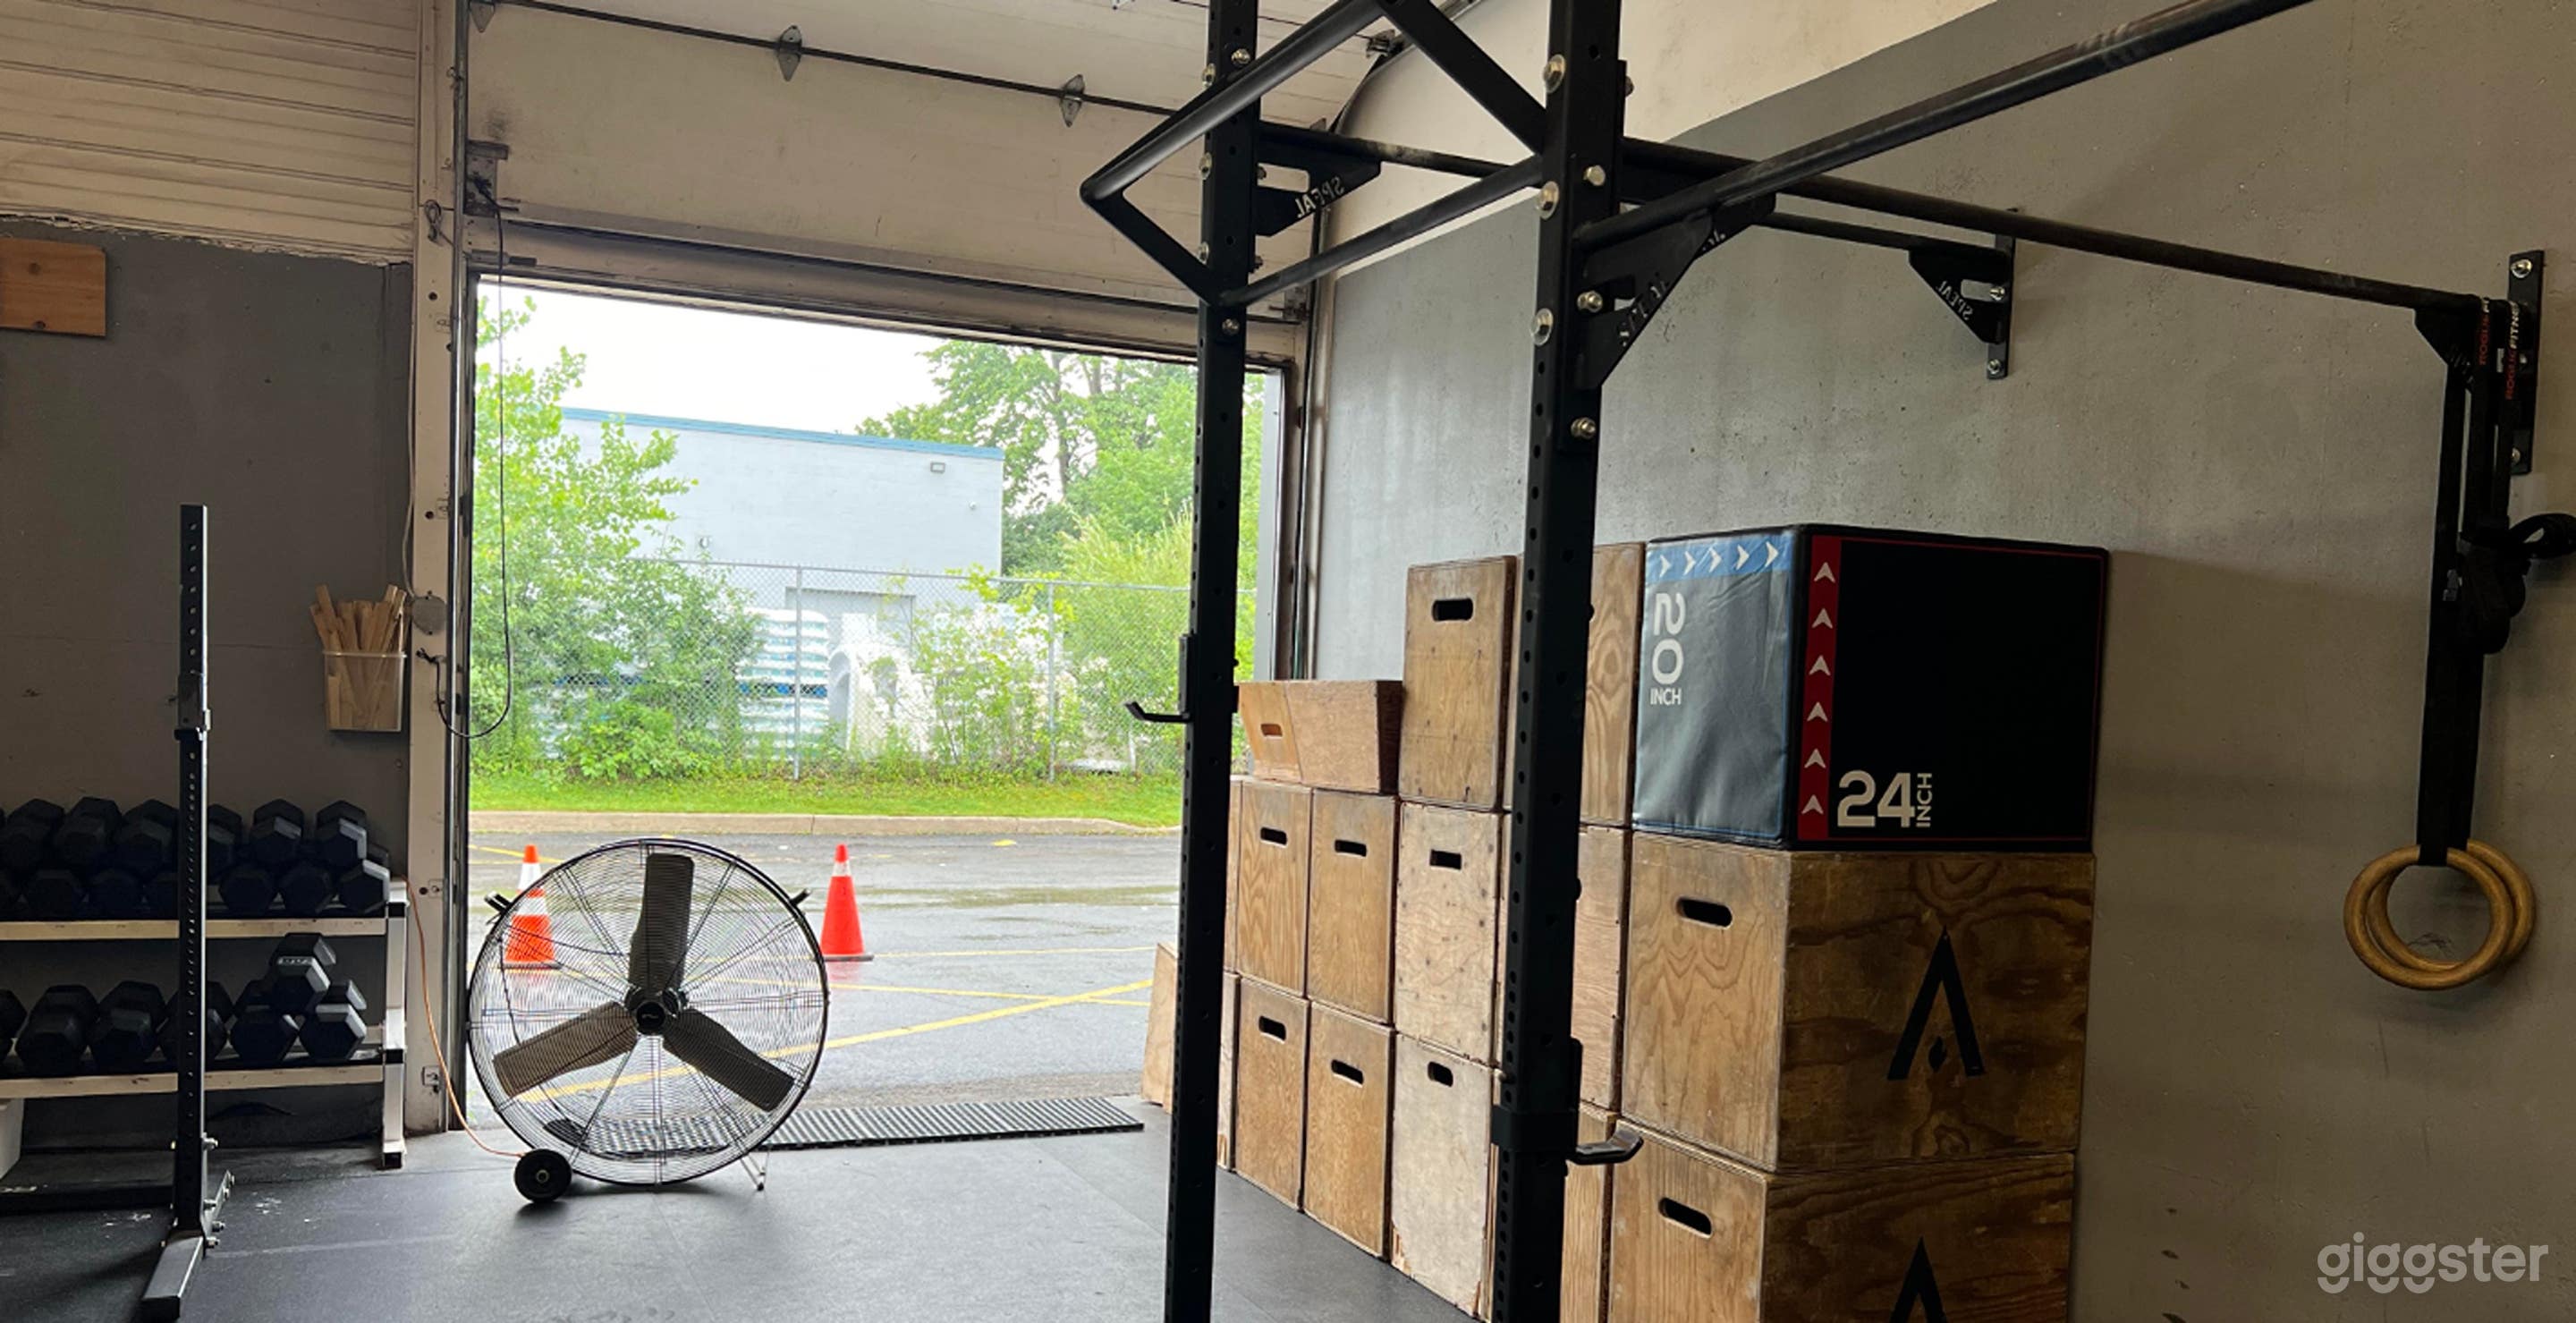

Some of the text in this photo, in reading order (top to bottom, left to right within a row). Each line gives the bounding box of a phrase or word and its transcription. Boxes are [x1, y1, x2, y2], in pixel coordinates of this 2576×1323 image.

[1652, 592, 1686, 685] 20
[1649, 687, 1682, 706] INCH
[1837, 769, 1932, 828] 24 INCH
